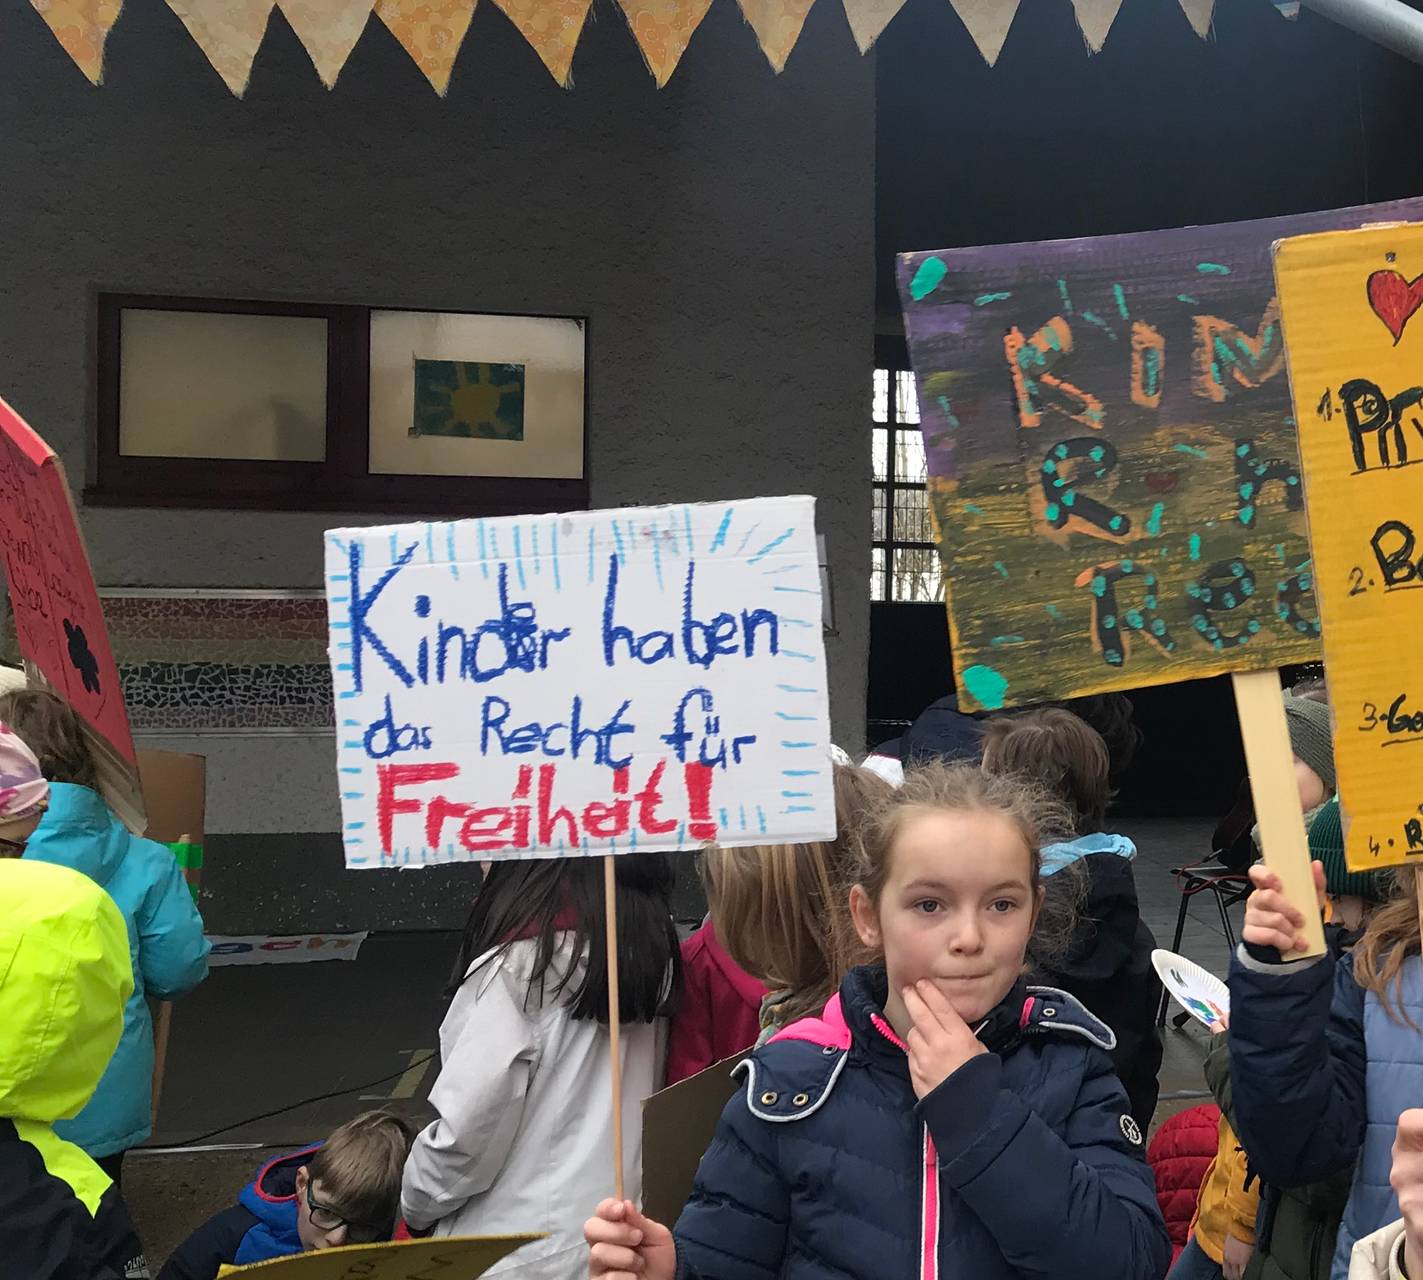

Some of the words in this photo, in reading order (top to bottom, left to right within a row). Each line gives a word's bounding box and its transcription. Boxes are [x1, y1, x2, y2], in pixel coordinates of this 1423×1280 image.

[1346, 567, 1375, 598] 2.
[348, 540, 572, 692] Kinder
[603, 551, 779, 670] haben
[363, 692, 433, 759] das
[480, 694, 637, 771] Recht
[660, 685, 757, 770] für
[1358, 702, 1388, 732] 3.
[376, 757, 719, 857] Freiheit!
[1368, 835, 1395, 857] 4.
